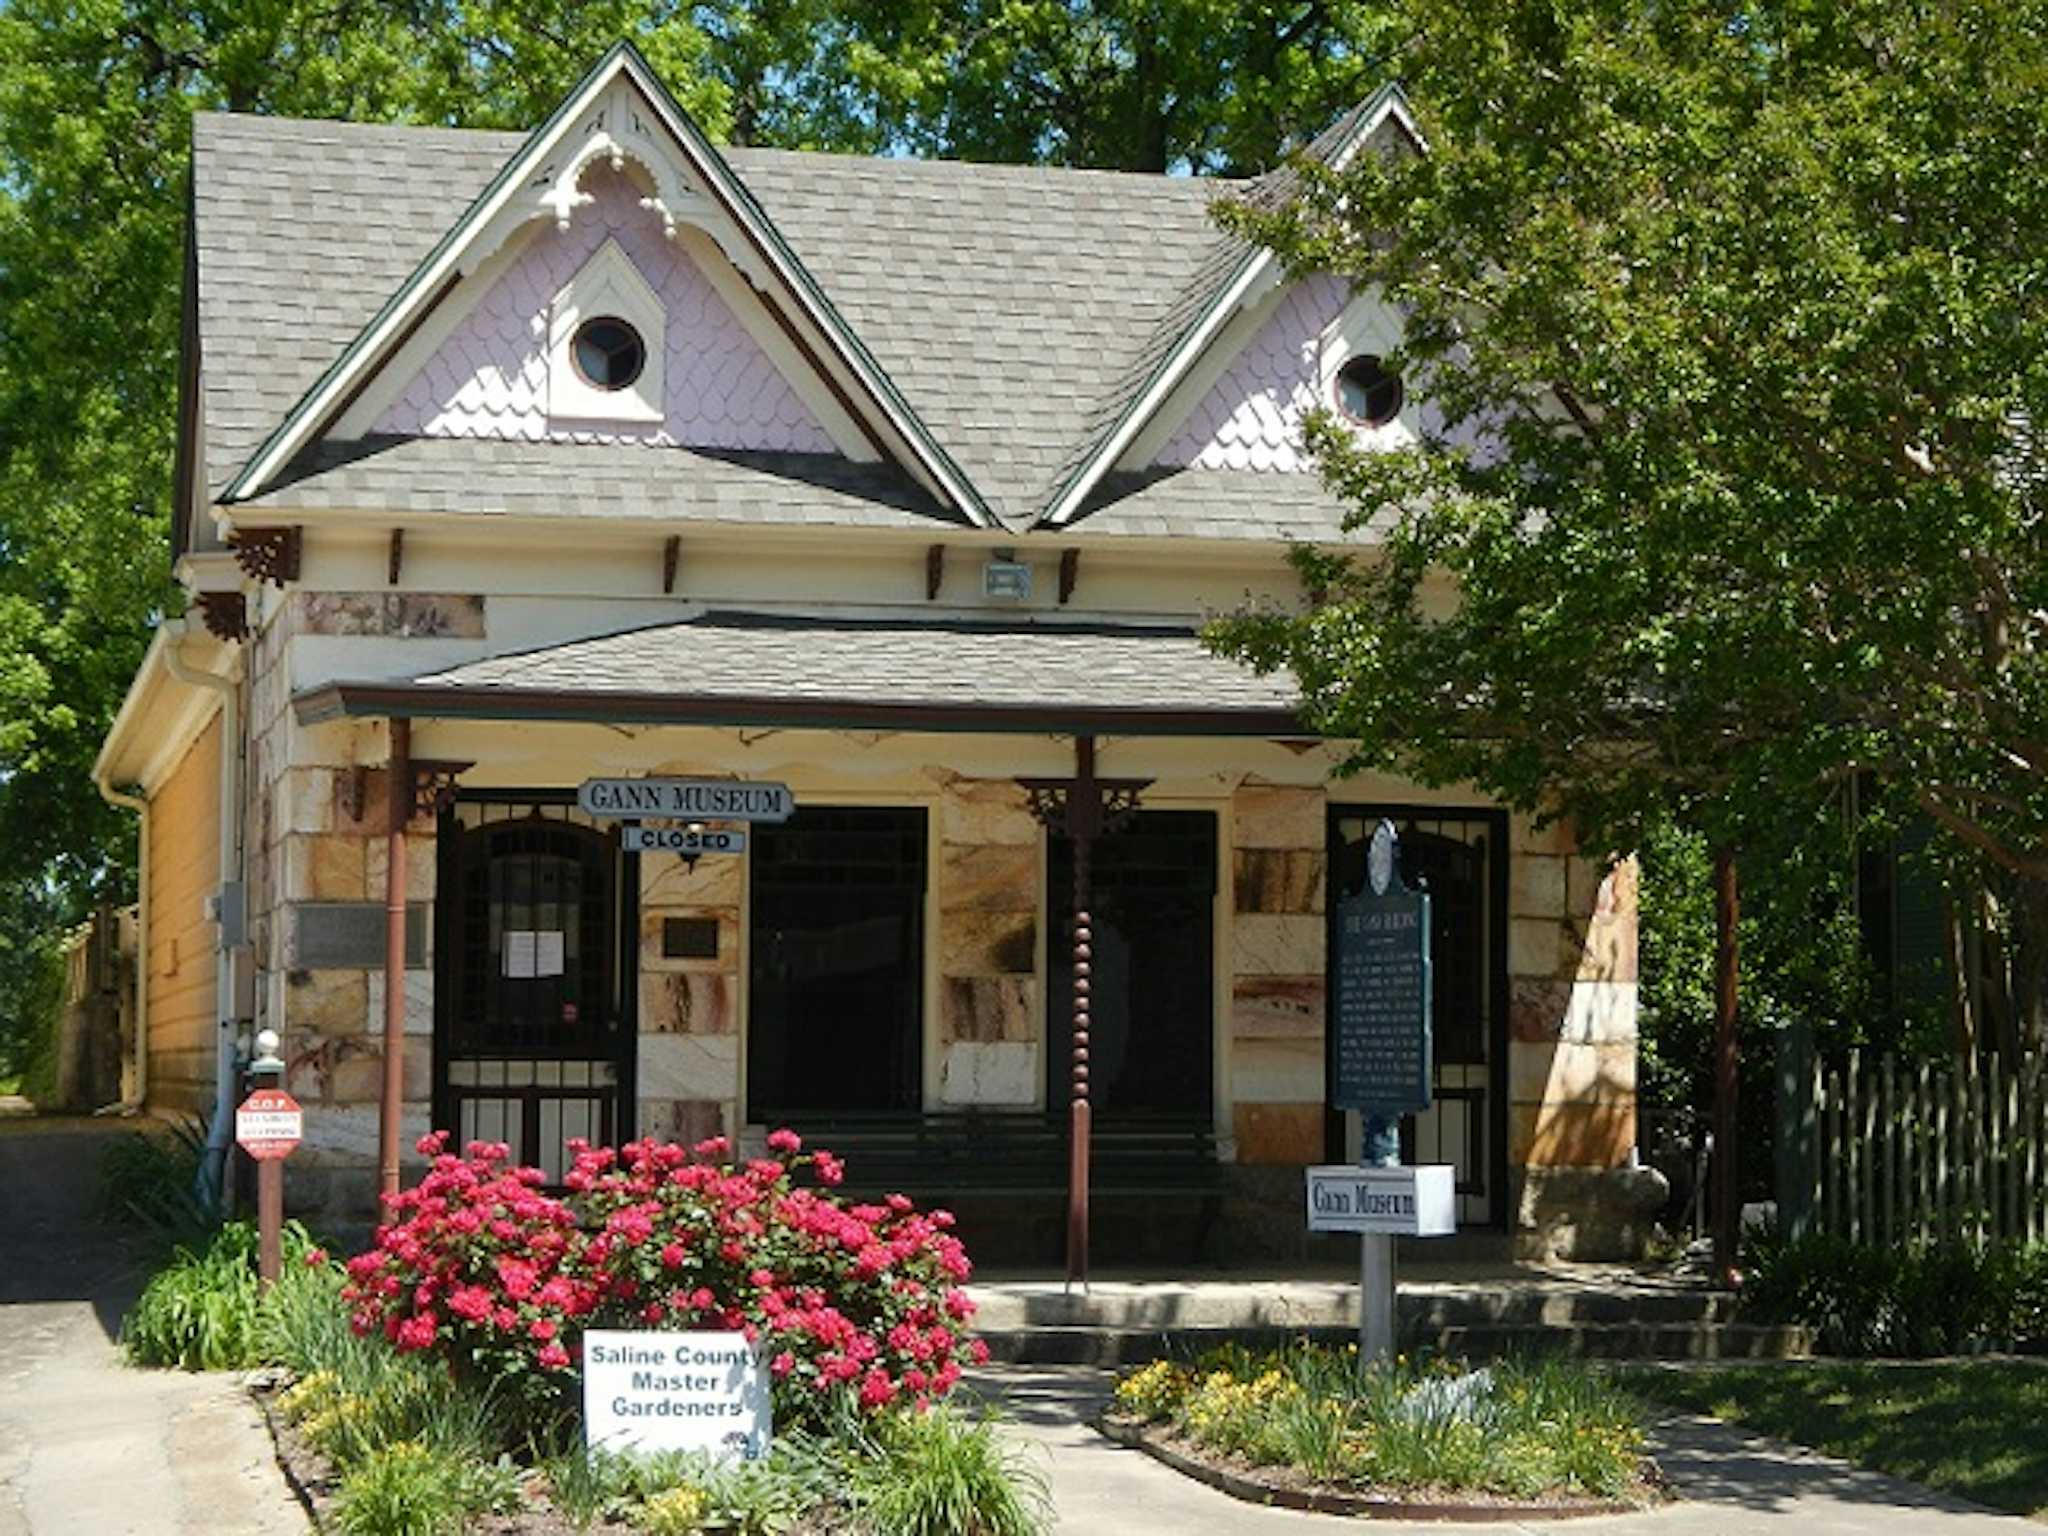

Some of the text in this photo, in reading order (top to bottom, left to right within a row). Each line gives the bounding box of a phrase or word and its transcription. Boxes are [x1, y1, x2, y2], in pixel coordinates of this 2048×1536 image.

[591, 783, 782, 813] GANN MUSEUM
[640, 831, 731, 849] CLOSED
[1313, 1182, 1416, 1215] Gann Museum
[591, 1346, 763, 1368] Saline County
[631, 1371, 721, 1392] Master
[612, 1396, 744, 1417] Gardeners
